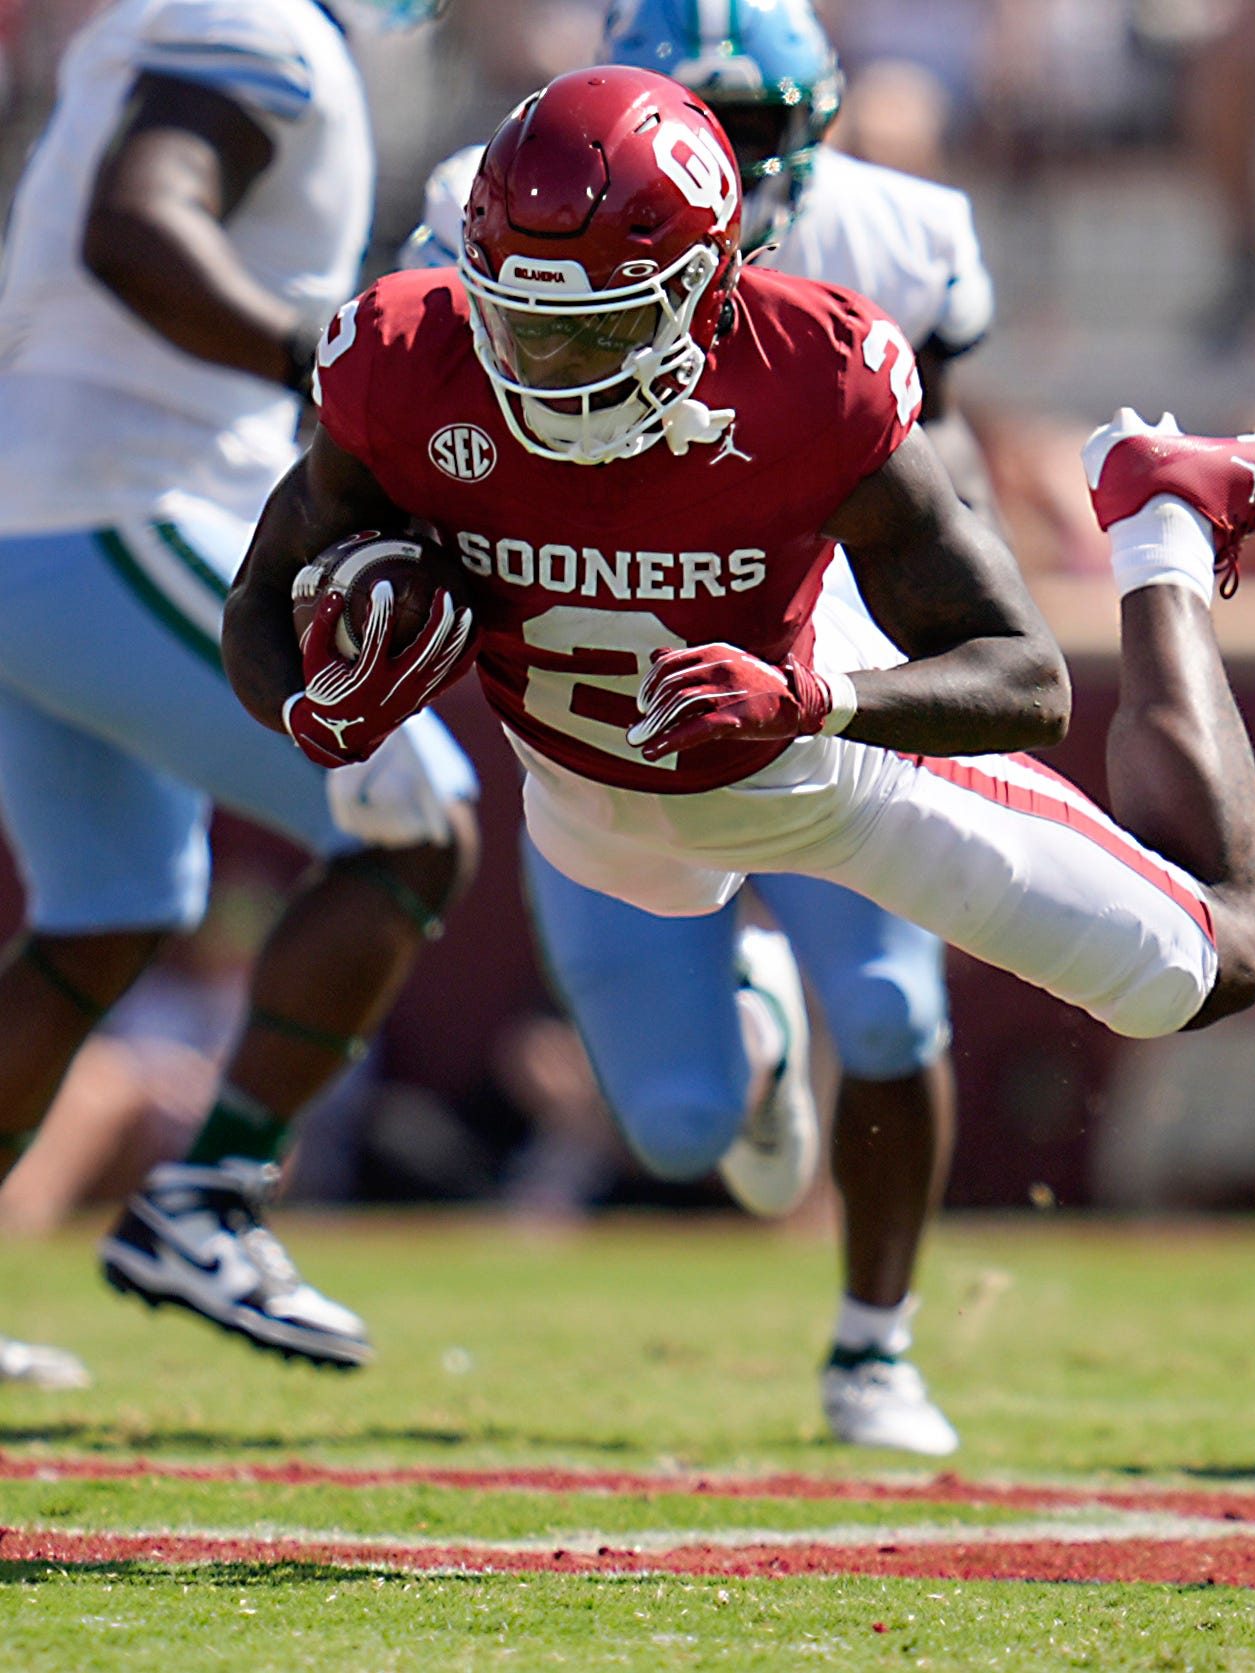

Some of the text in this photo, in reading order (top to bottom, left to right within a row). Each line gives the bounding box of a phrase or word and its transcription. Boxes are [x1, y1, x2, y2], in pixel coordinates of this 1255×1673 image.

[433, 427, 491, 478] SEC
[456, 530, 767, 600] SOONERS
[522, 605, 688, 771] 2
